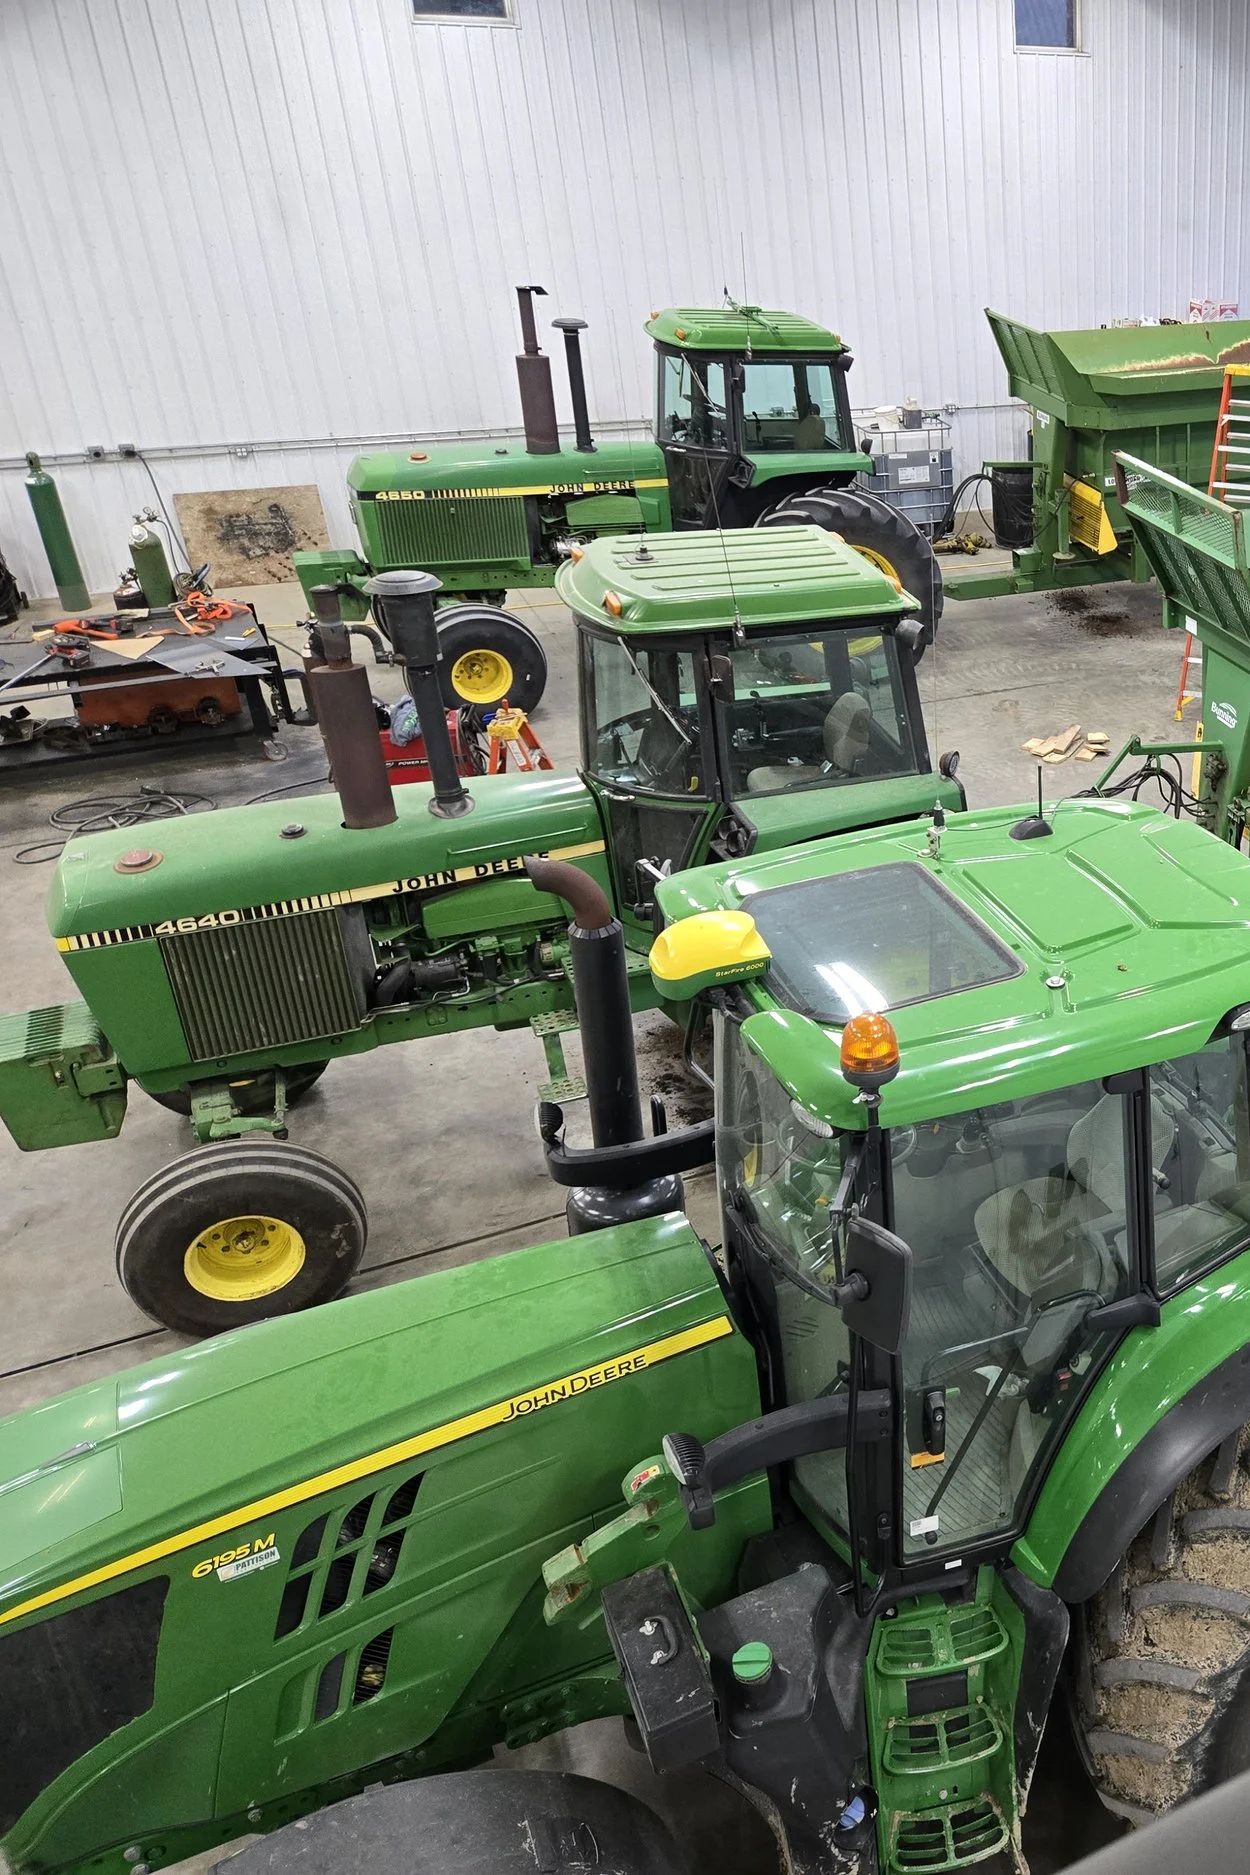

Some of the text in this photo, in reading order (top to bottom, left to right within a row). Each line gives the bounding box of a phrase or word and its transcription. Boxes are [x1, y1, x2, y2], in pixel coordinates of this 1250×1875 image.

[375, 480, 635, 501] 4650 JOHN DEERE
[155, 910, 240, 935] 4640
[393, 870, 457, 893] JOHN
[746, 962, 764, 971] 6000
[503, 1354, 646, 1420] JOHN DEERE
[235, 1549, 276, 1570] PATTISON
